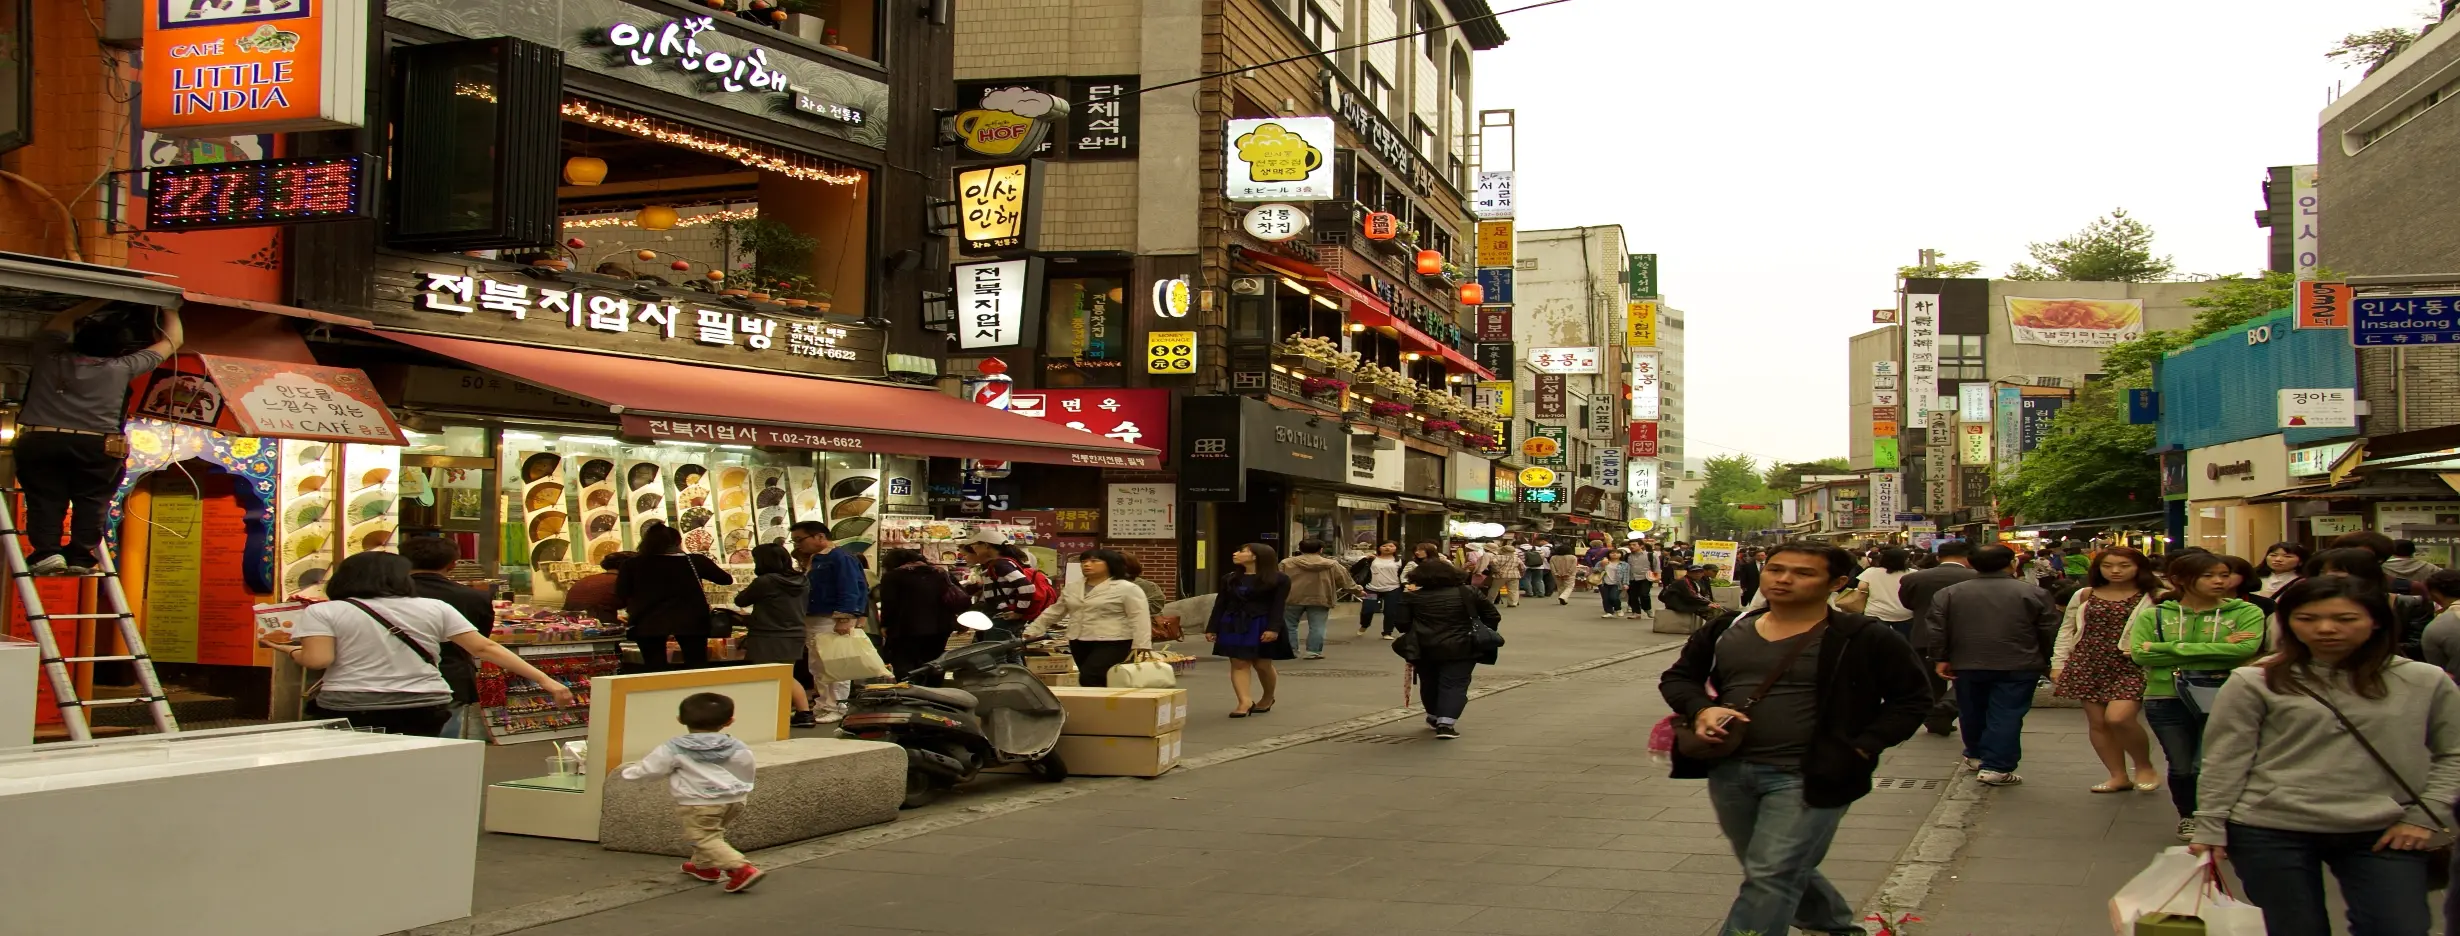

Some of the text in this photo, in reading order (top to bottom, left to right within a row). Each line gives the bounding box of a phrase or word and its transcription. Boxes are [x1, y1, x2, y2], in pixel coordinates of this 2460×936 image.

[170, 39, 224, 58] CAFÉ
[610, 17, 788, 92] 인산인해
[173, 60, 293, 91] LITTLE
[173, 86, 290, 115] INDIA
[1087, 85, 1125, 135] 단체석
[829, 104, 862, 124] 전통주
[978, 124, 1026, 143] HOF
[1078, 135, 1128, 150] 완비
[1373, 116, 1407, 174] 전통주점
[1261, 168, 1296, 176] 생맥주
[965, 168, 1020, 203] 인산
[968, 205, 1020, 240] 인해
[1258, 209, 1290, 220] 전통
[1257, 222, 1290, 234] 찻집
[426, 273, 778, 350] 전북지업사 필방
[974, 267, 1002, 343] 전북지업사
[2361, 318, 2450, 329] Insadong
[791, 344, 856, 360] T.734-6622
[1534, 353, 1578, 367] 홍콩
[1634, 362, 1657, 385] 홍콩
[276, 385, 333, 402] 인도를
[1542, 375, 1560, 413] 관성필방
[2292, 391, 2344, 405] 경아트
[263, 398, 364, 419] 느낄수 있는
[1594, 396, 1612, 434] 내산표구
[260, 417, 389, 437] 식사 CAFÉ 음료
[649, 420, 863, 449] 전북지업사 T.02-734-6622
[1127, 457, 1145, 466] 필방
[1601, 449, 1621, 487] 오동상자
[893, 485, 908, 494] 27-1
[1878, 482, 1893, 526] 인사아트프라자
[1056, 511, 1099, 521] 냉콩국수
